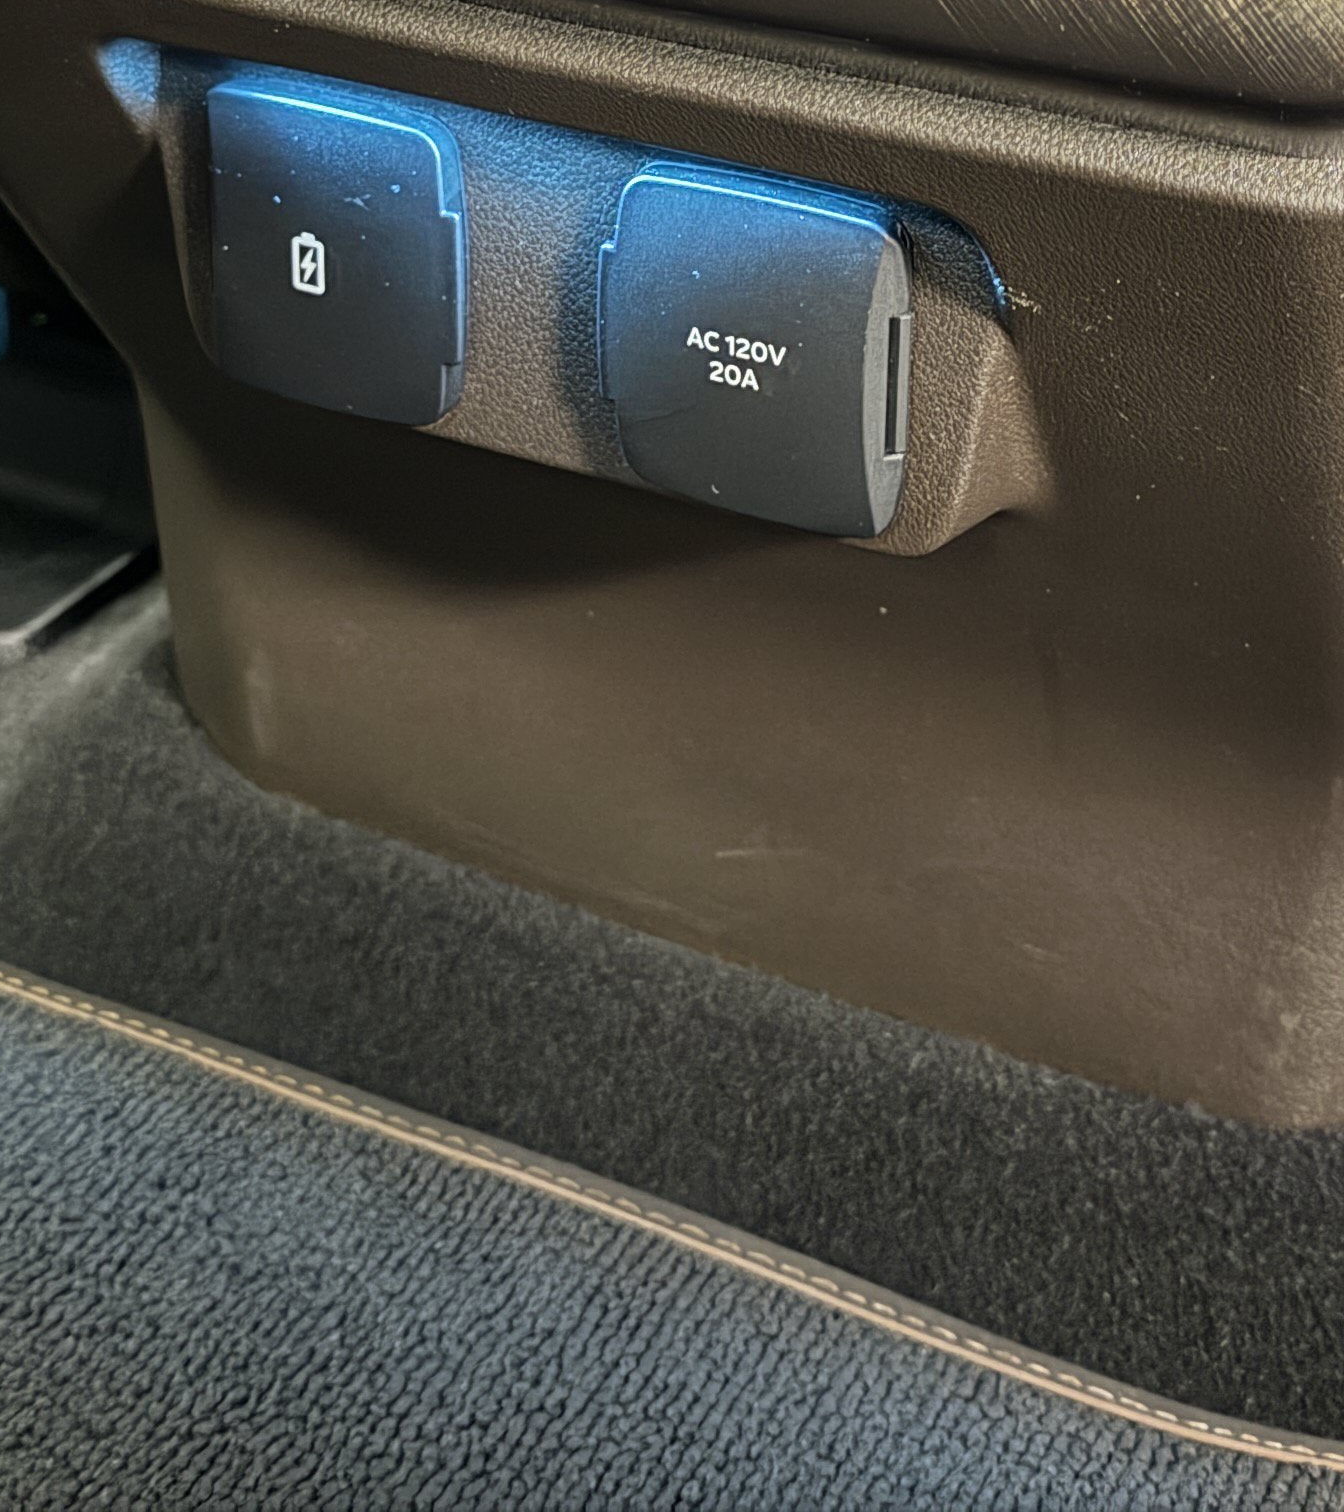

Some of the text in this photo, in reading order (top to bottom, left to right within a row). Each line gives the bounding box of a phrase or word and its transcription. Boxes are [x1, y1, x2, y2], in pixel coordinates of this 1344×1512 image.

[686, 326, 787, 366] AC 120V
[709, 360, 759, 392] 20A
